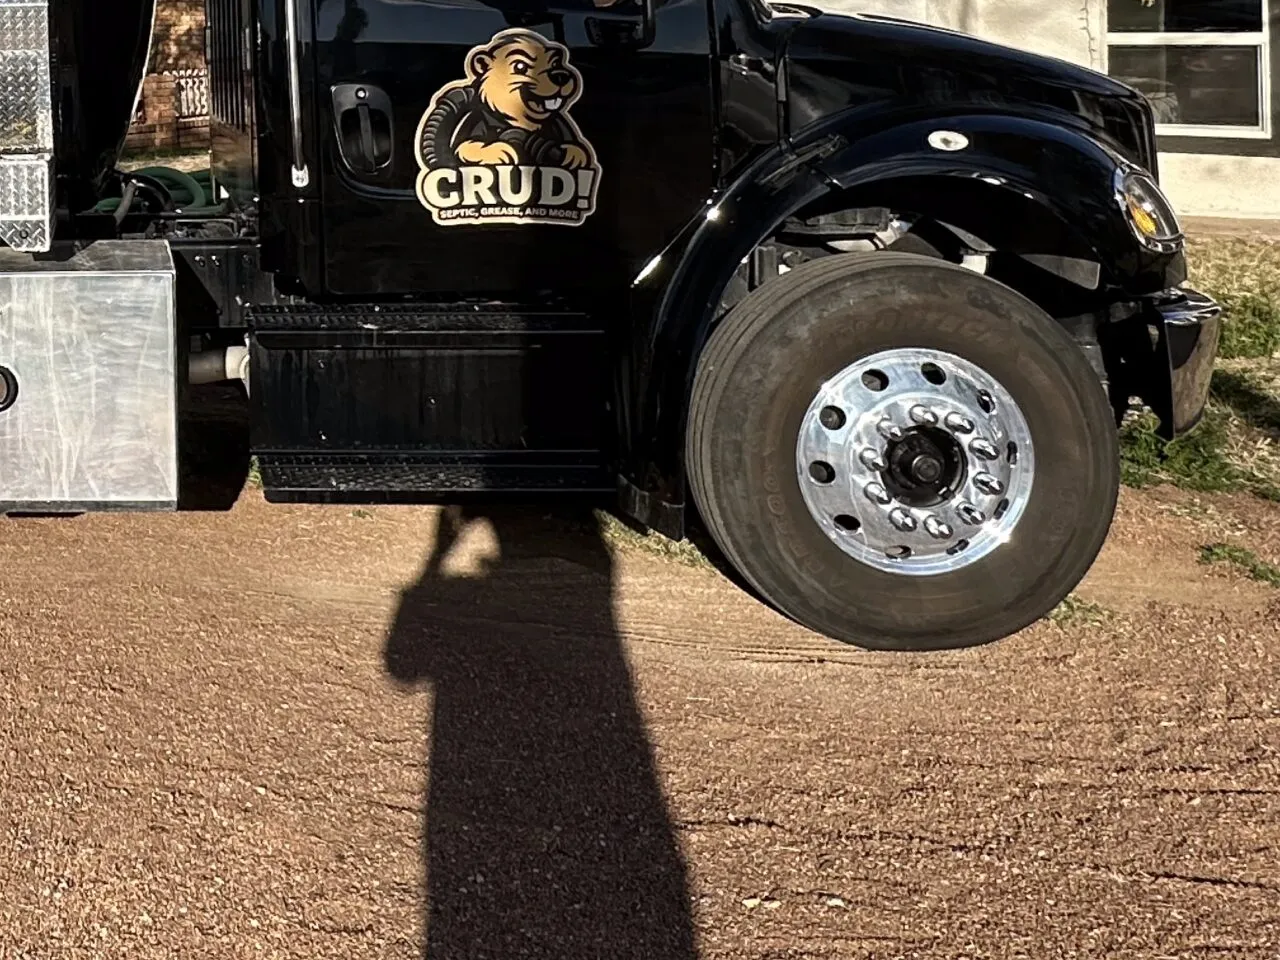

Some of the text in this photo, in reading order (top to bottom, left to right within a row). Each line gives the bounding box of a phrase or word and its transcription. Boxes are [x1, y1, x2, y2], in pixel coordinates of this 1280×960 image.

[423, 165, 595, 209] CRUD!
[439, 206, 580, 219] SEPTIC, GREASE, AND MORE
